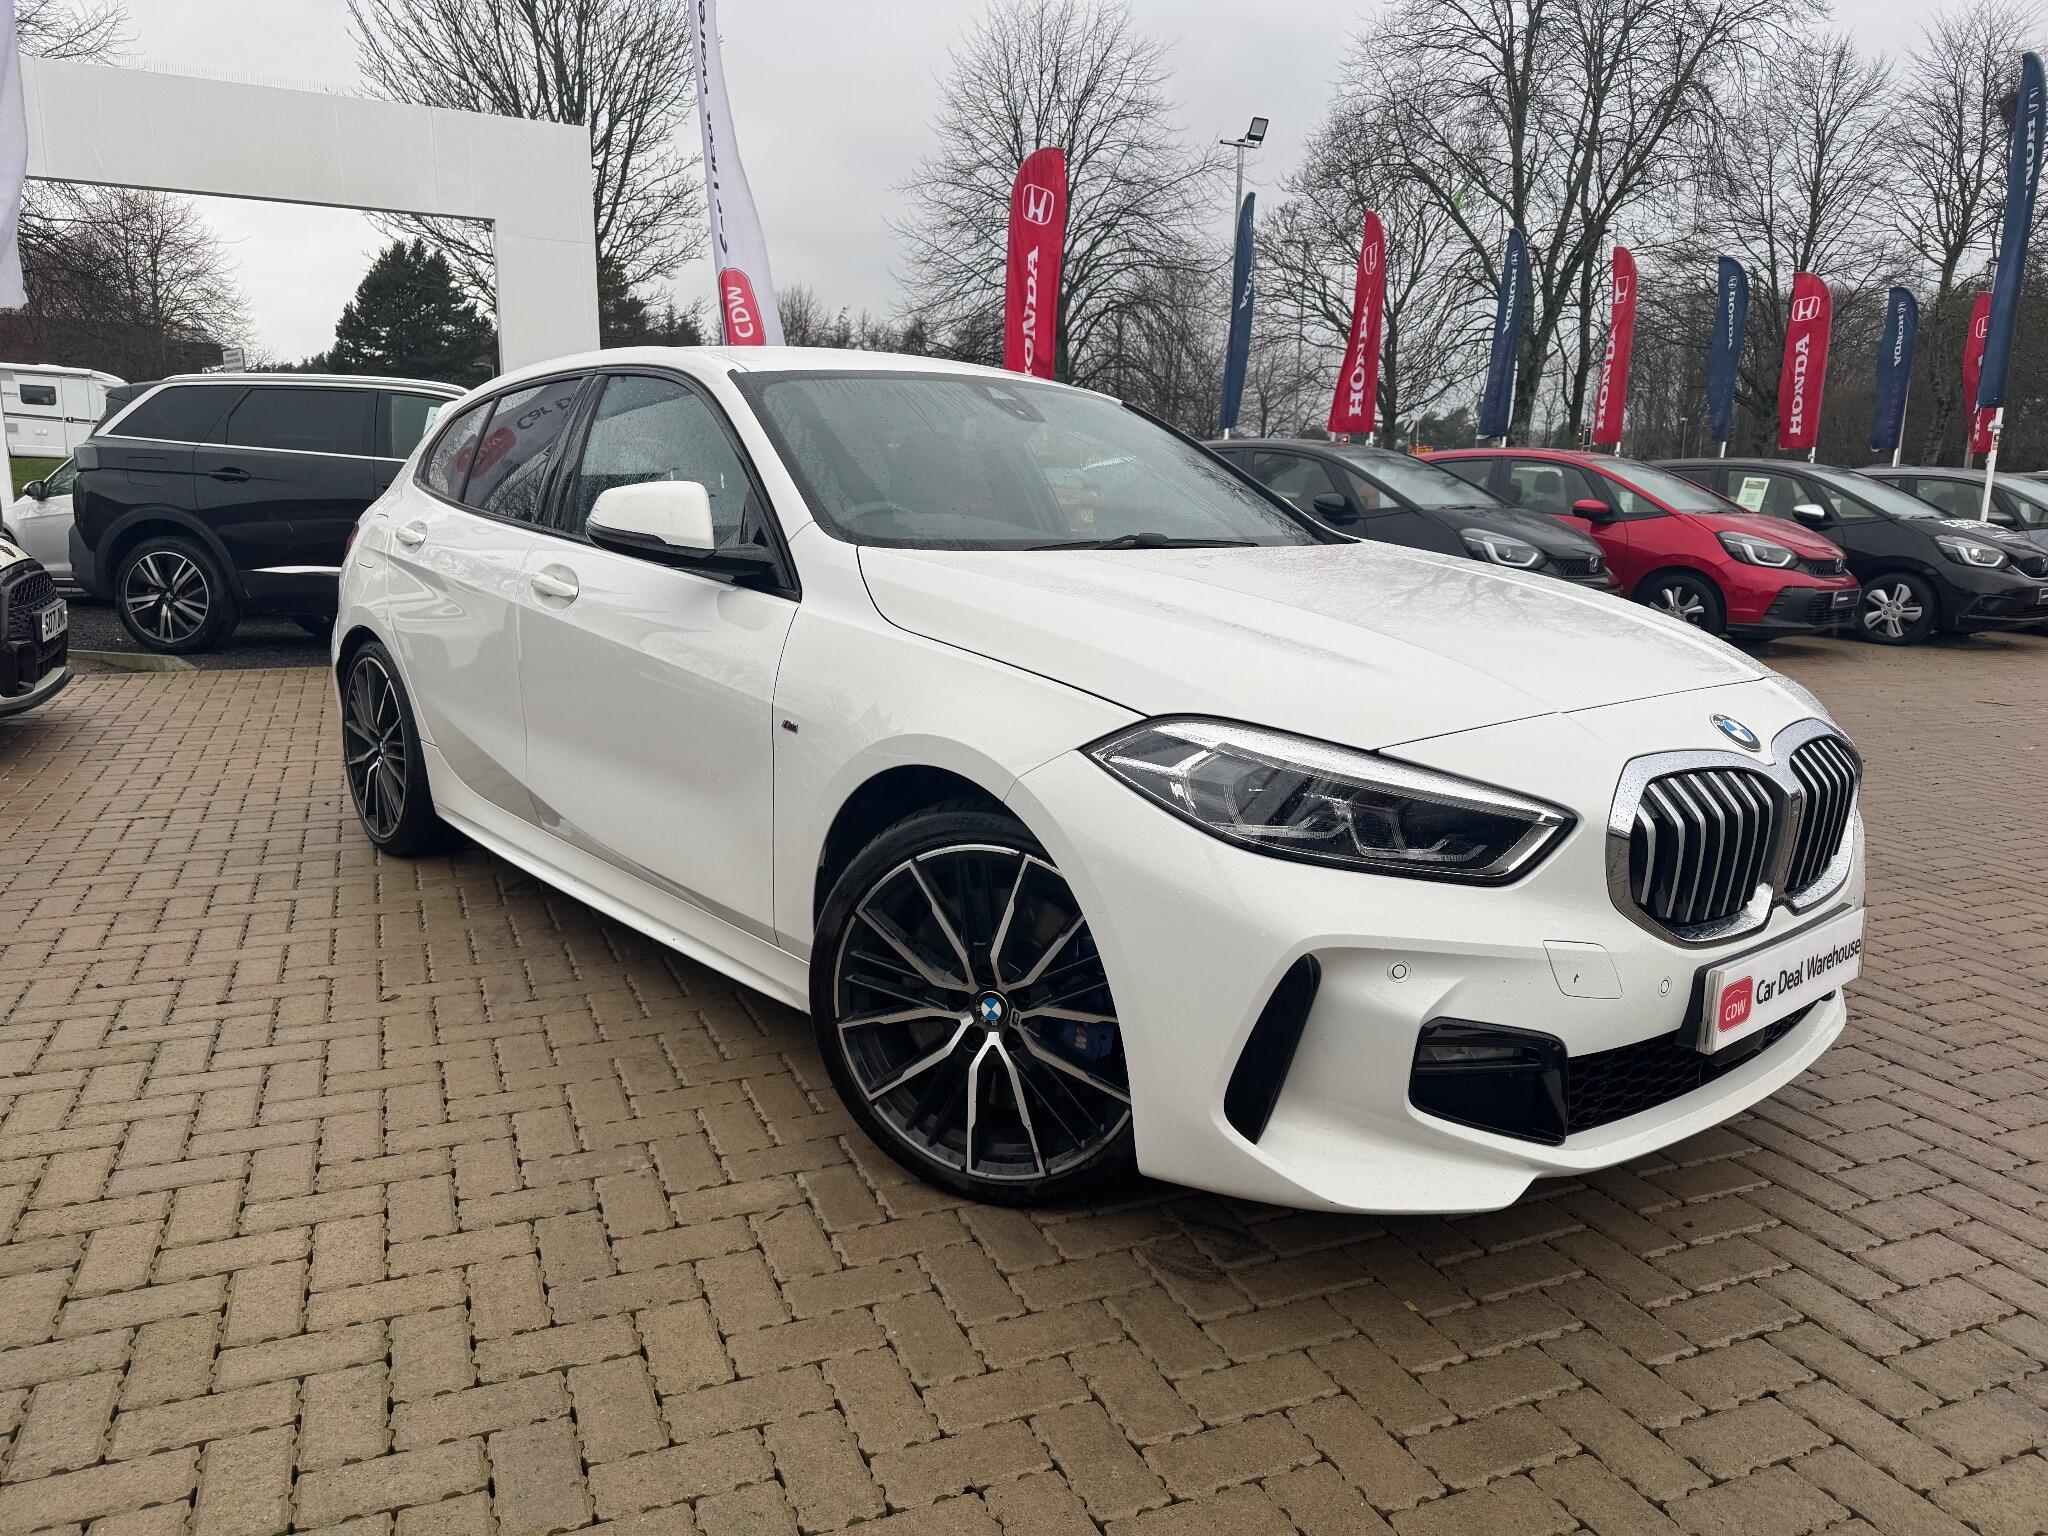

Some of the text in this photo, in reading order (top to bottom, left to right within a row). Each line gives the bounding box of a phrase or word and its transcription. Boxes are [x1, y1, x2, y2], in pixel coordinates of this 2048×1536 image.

[698, 0, 709, 94] Ware
[2025, 117, 2036, 201] HON
[727, 286, 754, 338] CDW
[1502, 268, 1518, 334] HONDA
[1727, 292, 1738, 350] HONDA
[1893, 315, 1904, 367] HONDA
[1789, 333, 1810, 435] HONDA
[1756, 938, 1861, 1004] Car Deal Warehouse
[1725, 1000, 1747, 1022] CDW
